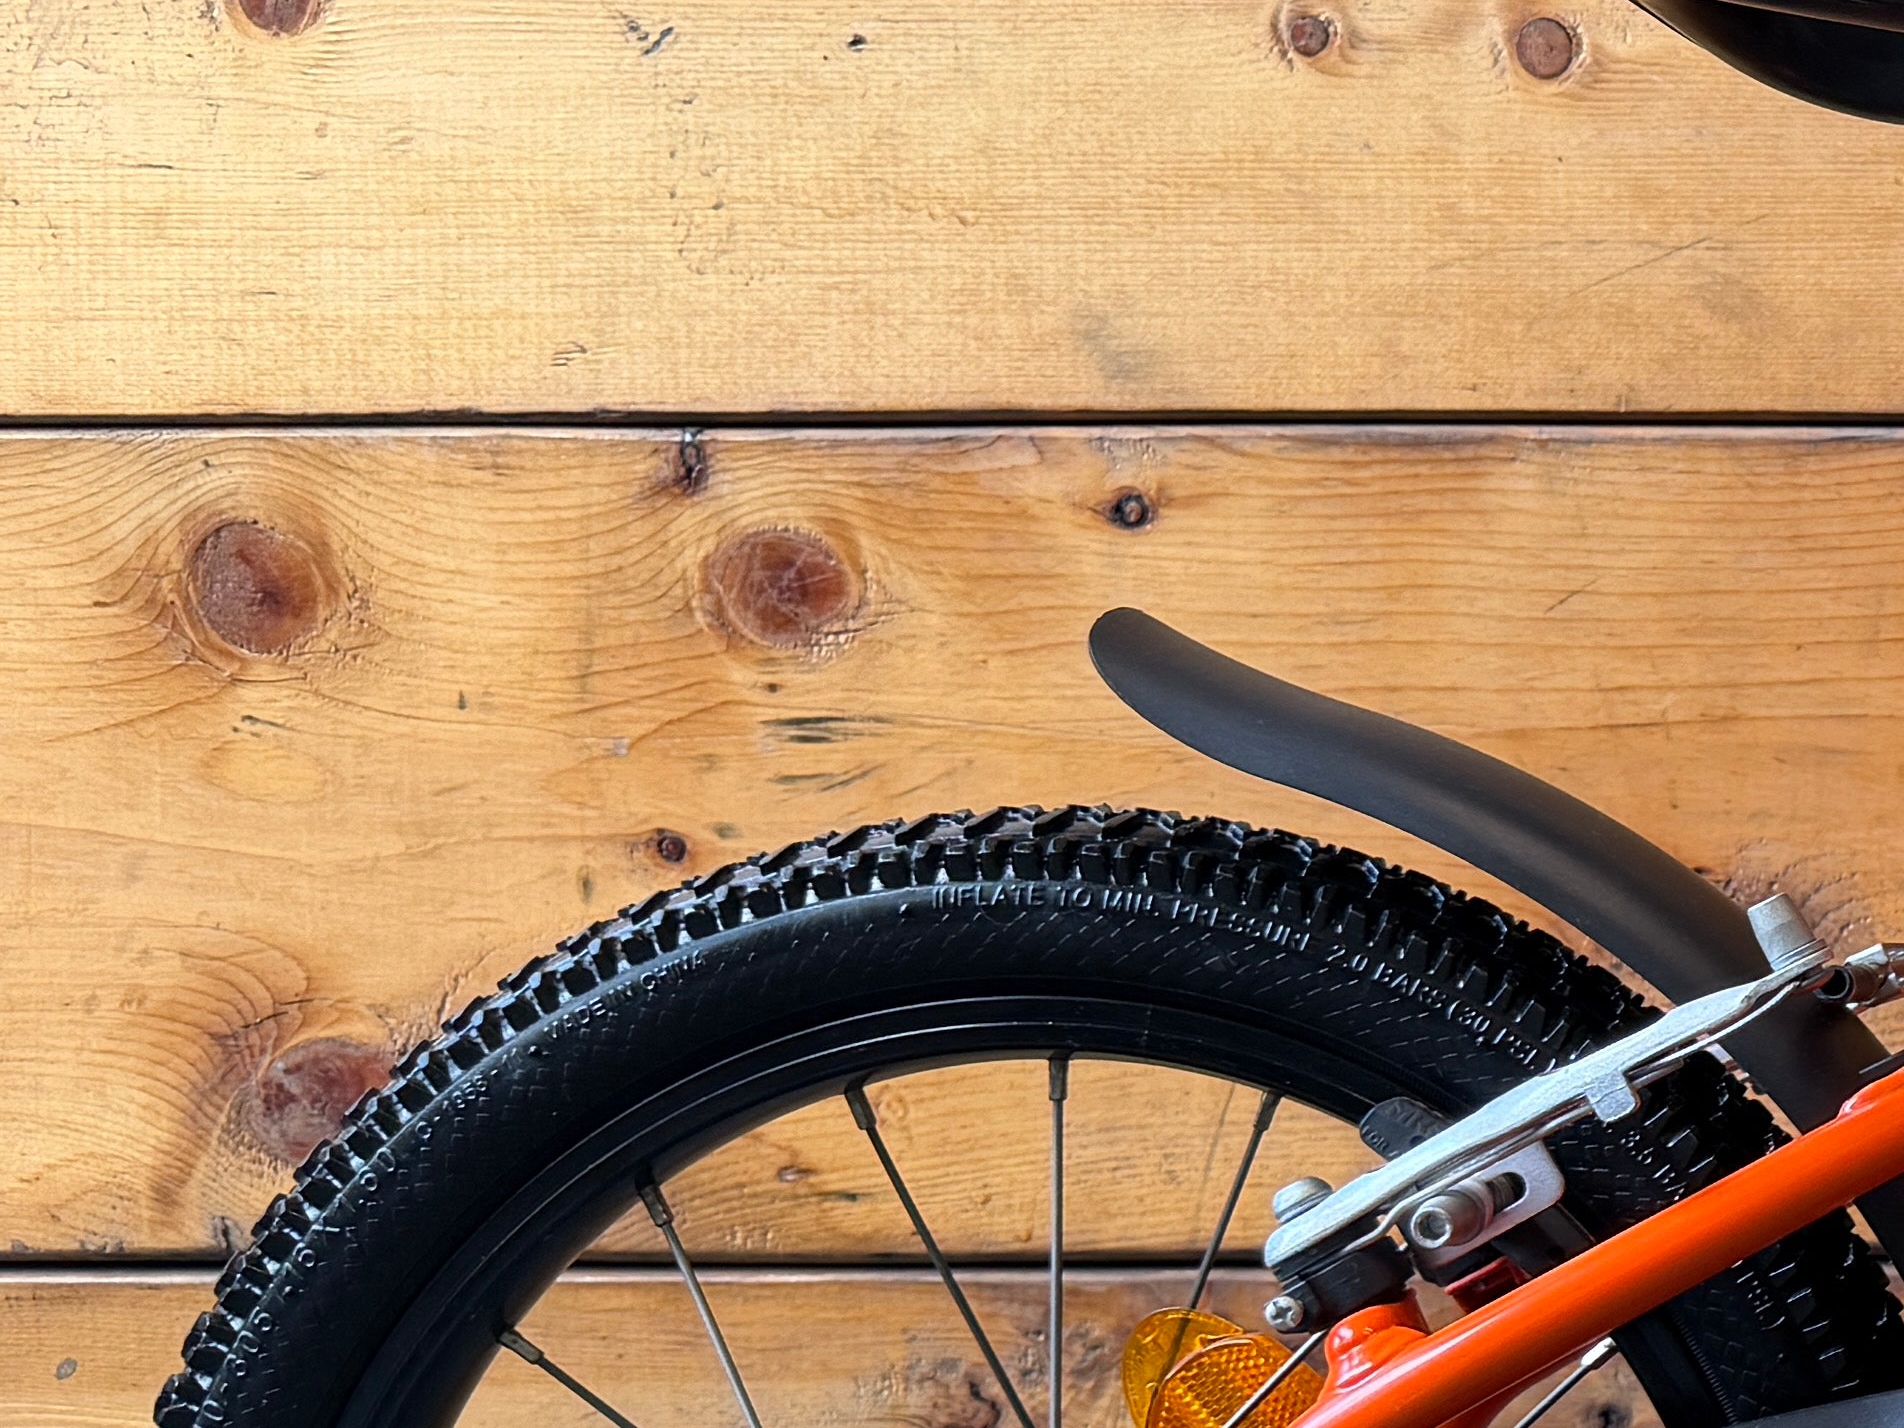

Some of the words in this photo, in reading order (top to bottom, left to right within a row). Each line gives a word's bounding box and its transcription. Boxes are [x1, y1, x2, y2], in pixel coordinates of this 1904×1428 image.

[541, 996, 607, 1044] MADE
[637, 948, 706, 992] CHINA
[931, 884, 1045, 908] INFLATE
[1055, 885, 1091, 908] TO
[1168, 892, 1318, 959] PRESSURE
[1323, 939, 1370, 977] 2.0
[1369, 957, 1448, 1015] BARS
